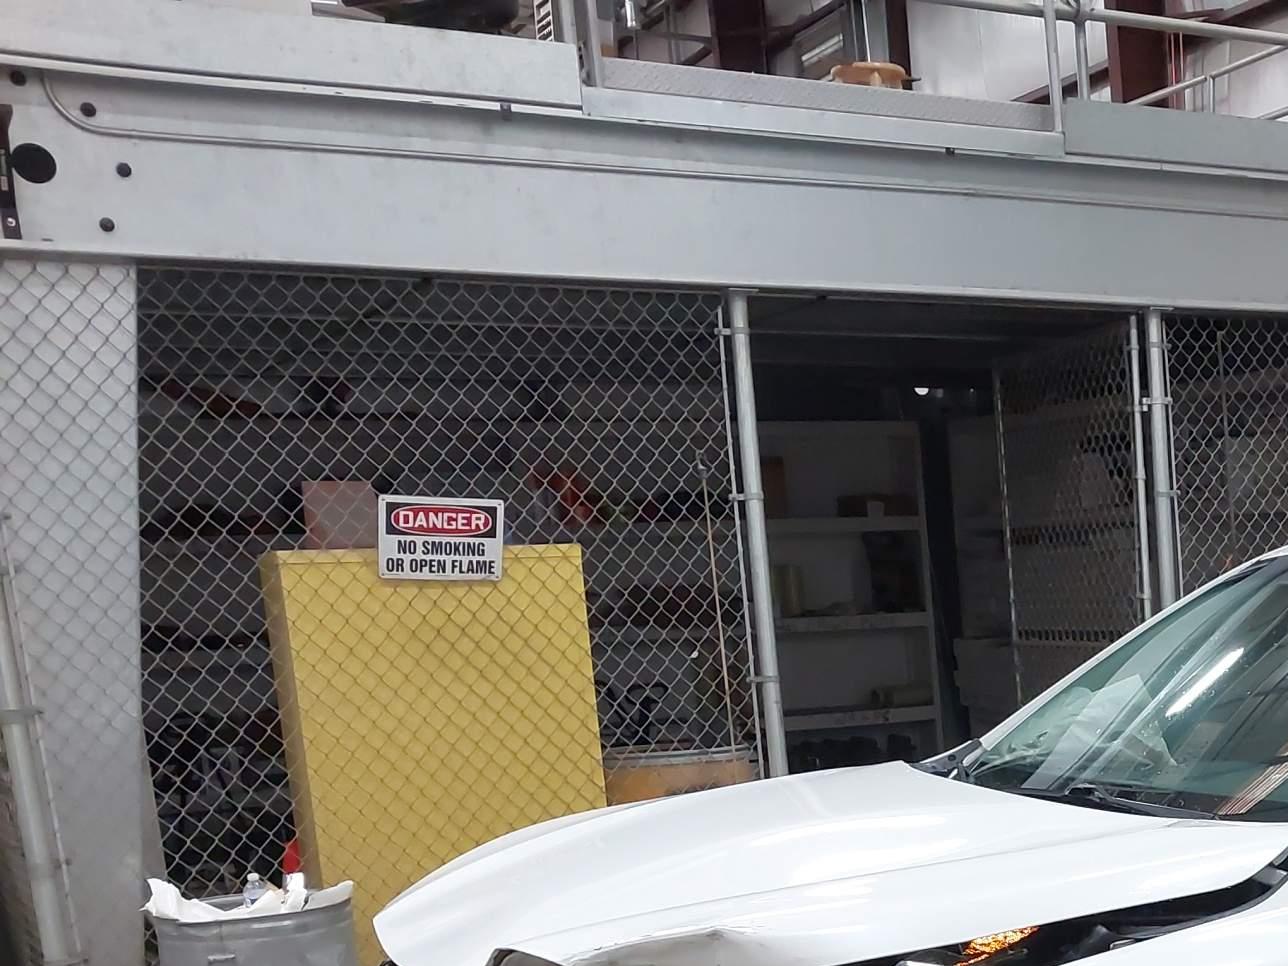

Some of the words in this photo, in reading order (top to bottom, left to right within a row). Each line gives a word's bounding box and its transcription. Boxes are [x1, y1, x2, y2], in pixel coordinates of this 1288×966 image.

[398, 511, 485, 530] DANGER
[397, 540, 417, 555] NO
[422, 541, 486, 557] SMOKING
[386, 557, 405, 573] OR
[409, 558, 447, 574] OPEN
[451, 559, 496, 575] FLAME
